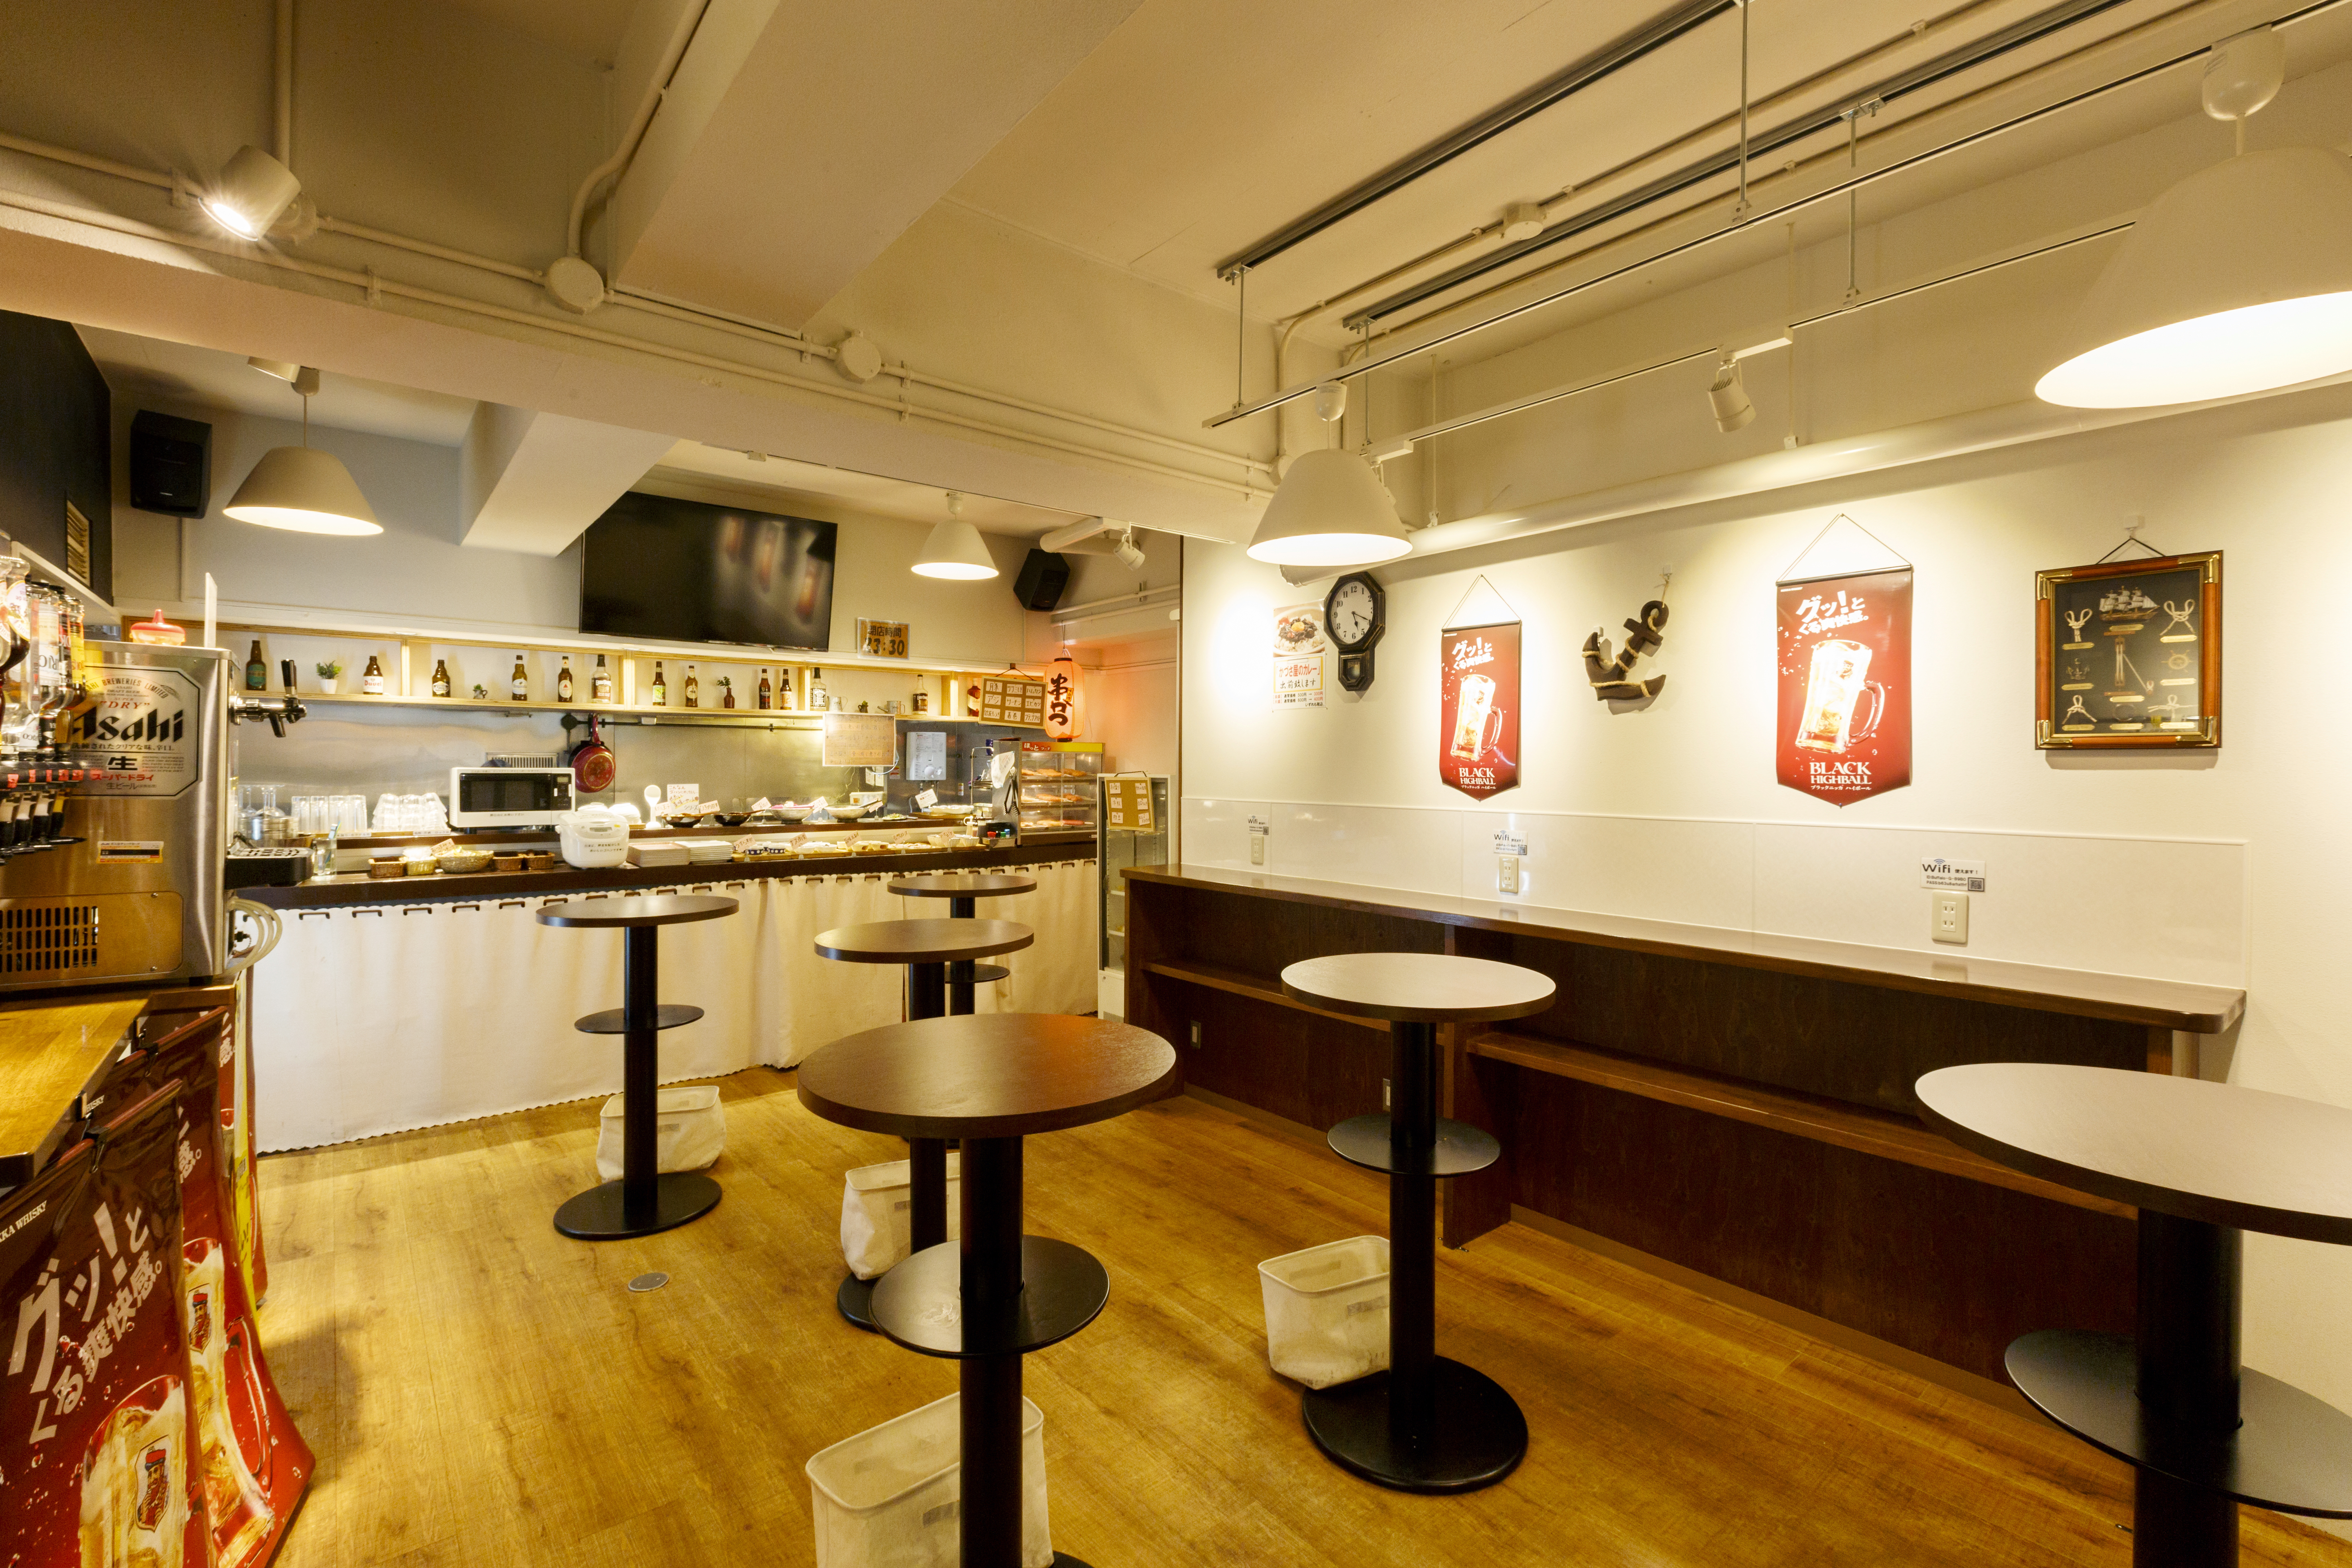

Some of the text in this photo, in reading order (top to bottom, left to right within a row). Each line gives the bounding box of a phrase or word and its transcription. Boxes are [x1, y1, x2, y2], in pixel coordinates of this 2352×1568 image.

[989, 683, 999, 691] 豚
[1280, 678, 1316, 688] 出前致します
[102, 678, 142, 686] BREWERIES
[144, 683, 169, 699] LIMITED
[73, 707, 183, 742] Asahi
[1024, 743, 1039, 751] ほっと
[107, 756, 138, 771] 生
[1809, 762, 1871, 775] BLACK
[1459, 768, 1495, 777] BLACK
[1811, 775, 1872, 784] HIGHBALL
[1922, 864, 1950, 873] Wifi
[15, 1200, 47, 1230] WHISKY
